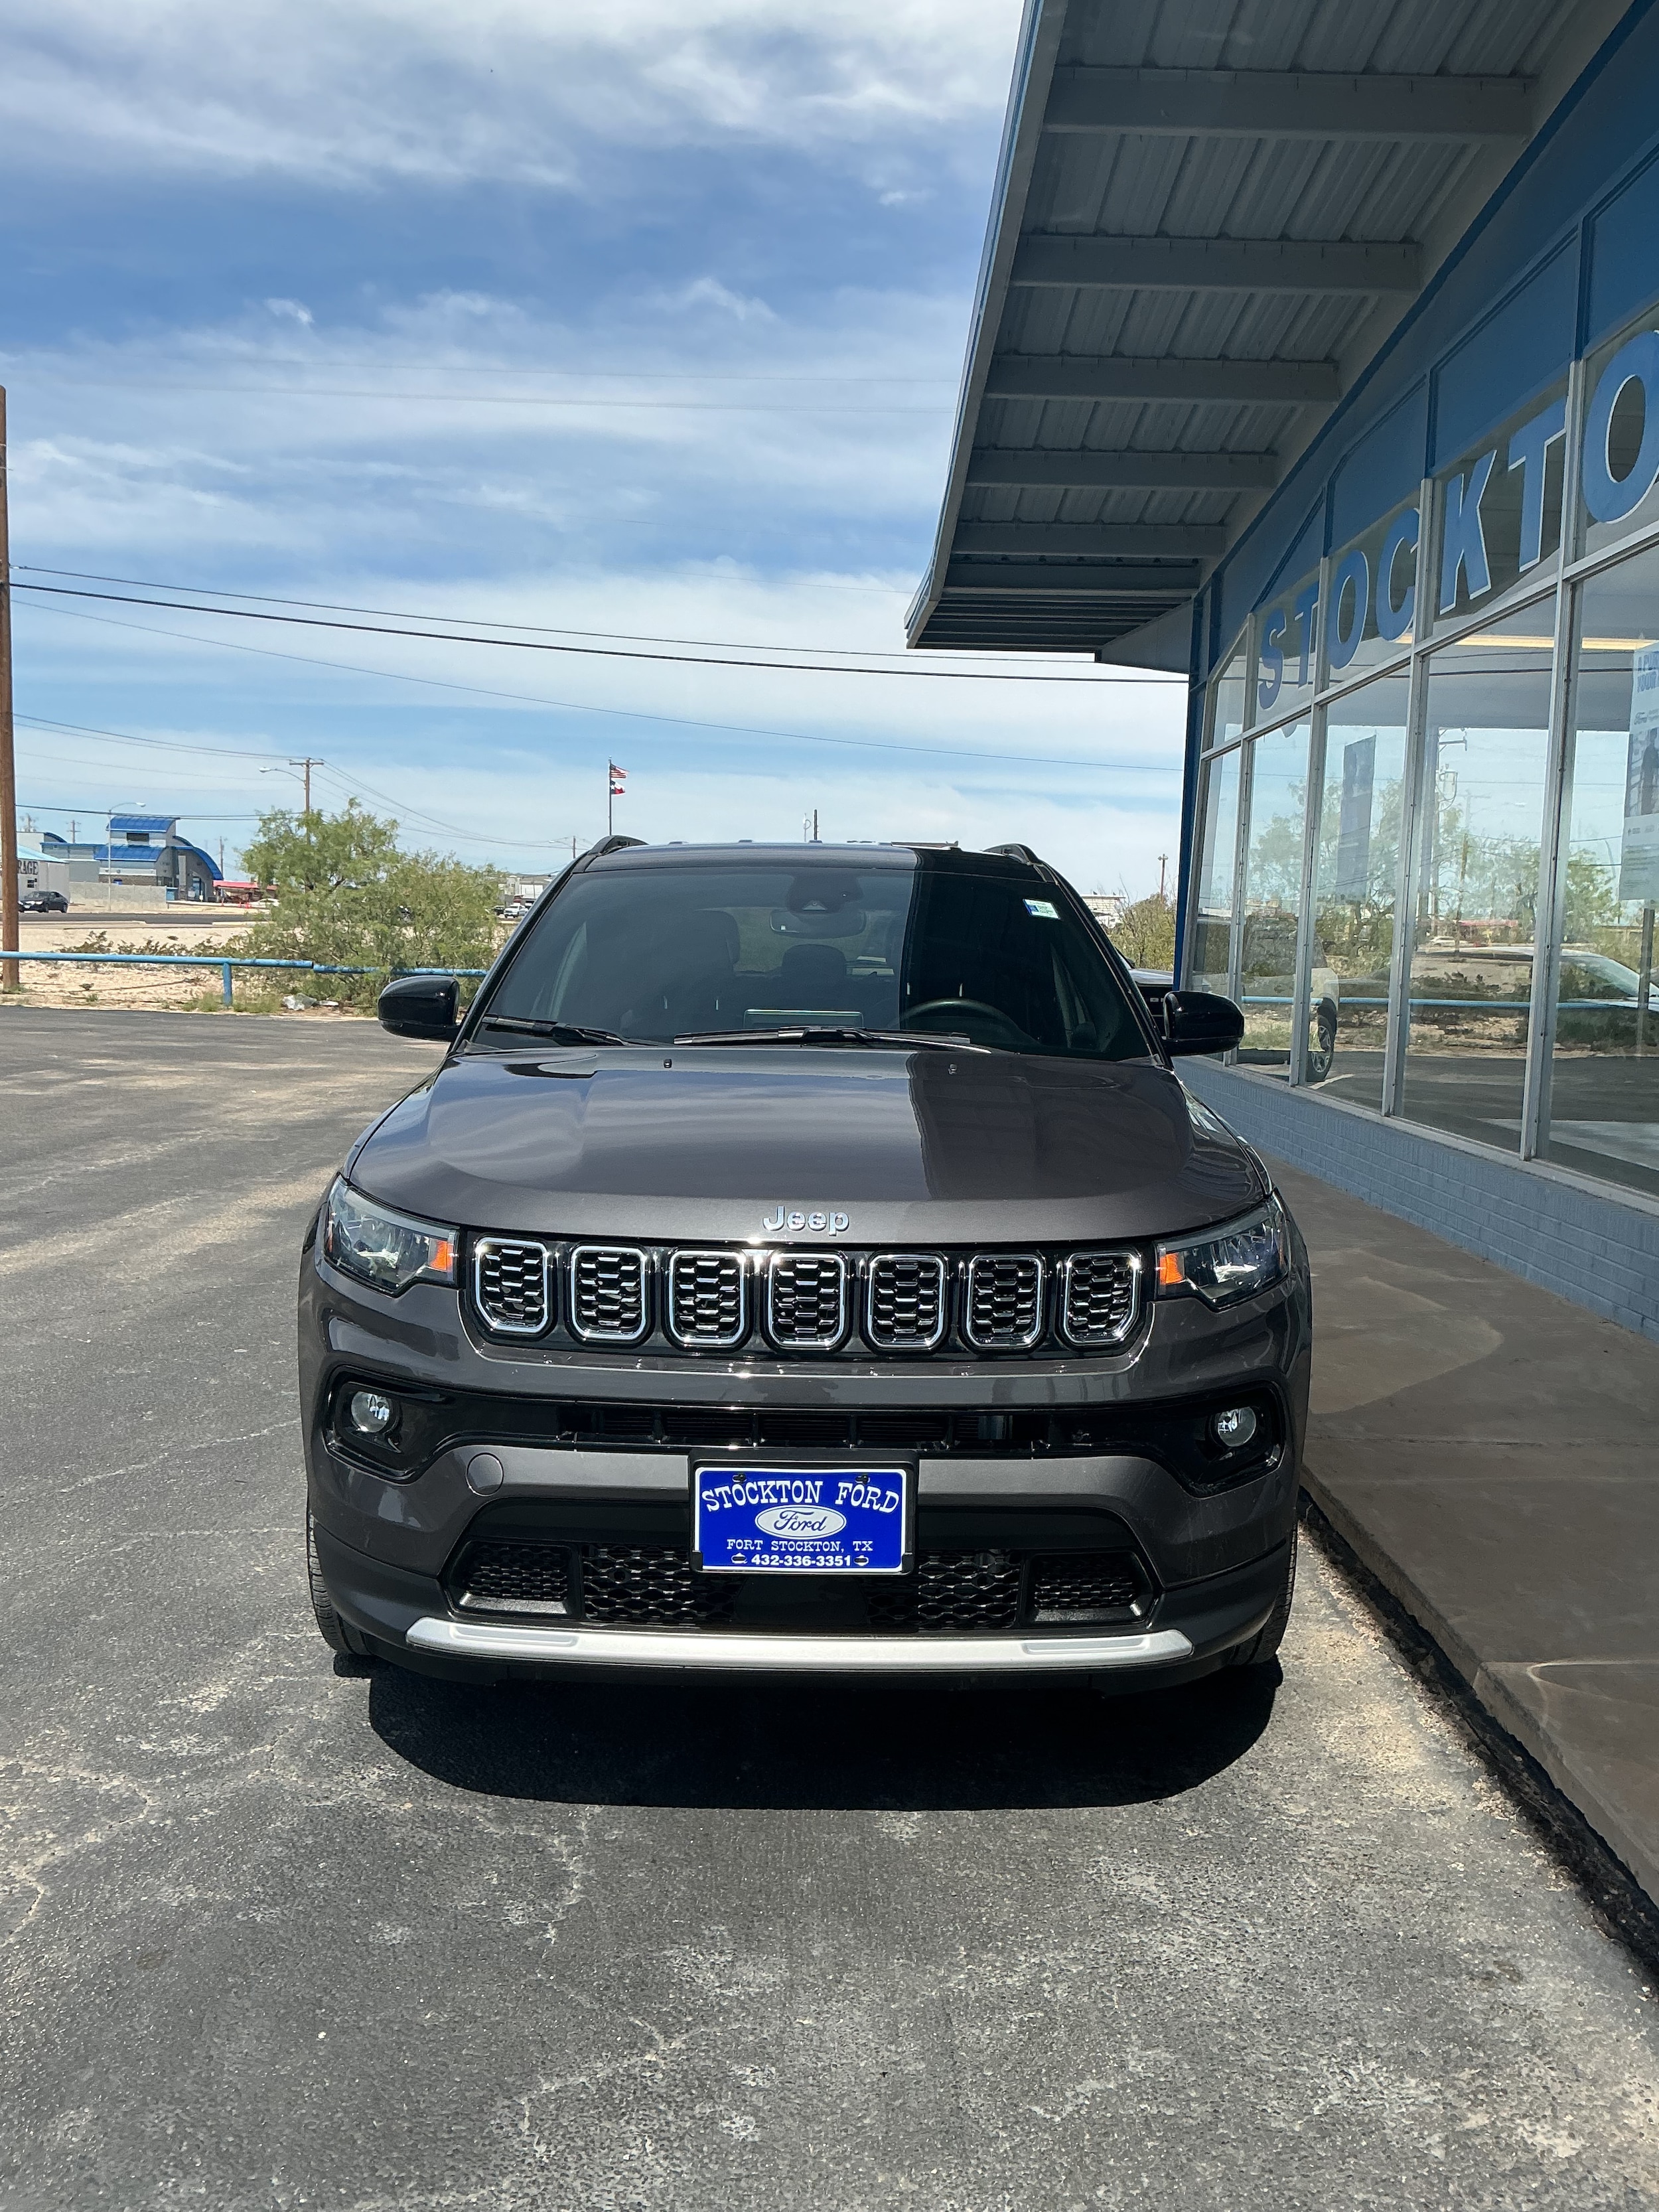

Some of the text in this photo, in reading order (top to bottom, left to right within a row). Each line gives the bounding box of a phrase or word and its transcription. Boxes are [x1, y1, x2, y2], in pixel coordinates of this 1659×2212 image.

[1258, 330, 1659, 709] STOCKTO
[763, 1205, 849, 1236] Jeep
[701, 1480, 900, 1514] STOCKTON FORD
[773, 1510, 828, 1532] Ford
[727, 1539, 873, 1552] FORT STOCKTON, TX
[751, 1554, 851, 1566] 432-336-3351
